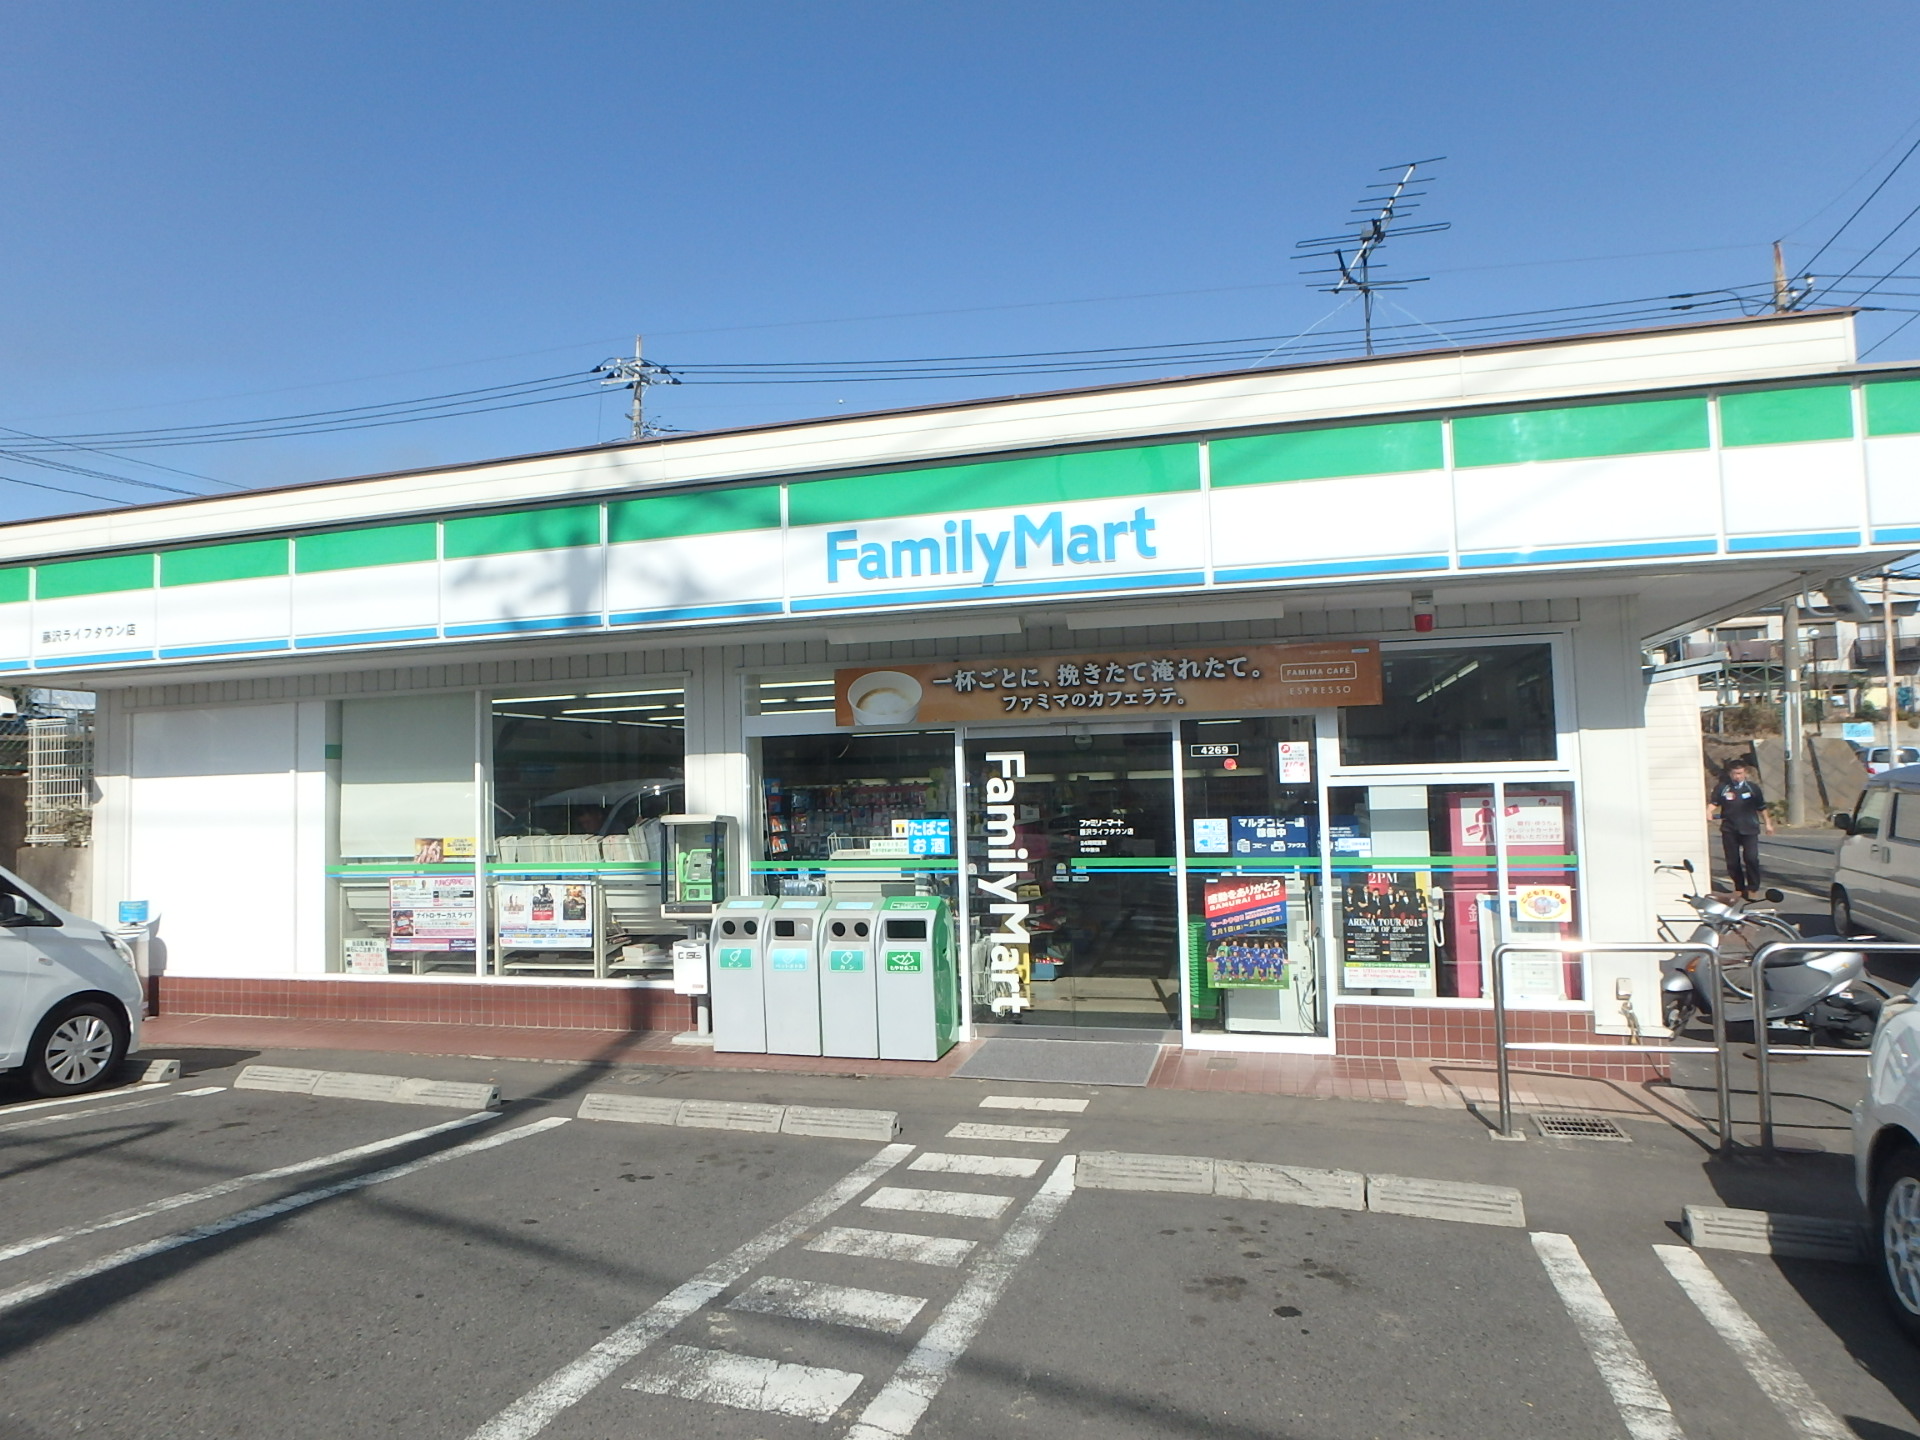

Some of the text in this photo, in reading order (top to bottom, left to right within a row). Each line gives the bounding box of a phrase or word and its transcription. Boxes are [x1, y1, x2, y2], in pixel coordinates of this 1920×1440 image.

[826, 506, 1157, 587] FamilyMart
[932, 656, 1261, 692] 一杯ごとに、挽きたて淹れたて。
[1286, 668, 1323, 676] FAMIMA
[1289, 685, 1351, 695] ESPRESSO
[1002, 687, 1186, 712] ファミマのカフェラテ。
[1200, 746, 1229, 755] 4269
[908, 821, 949, 836] たばこ
[1079, 819, 1124, 827] ファミリーマート
[977, 750, 1031, 1015] FamilyMart
[1368, 872, 1398, 884] 2PM
[1348, 918, 1376, 927] ARENA
[1378, 918, 1401, 927] TOUR
